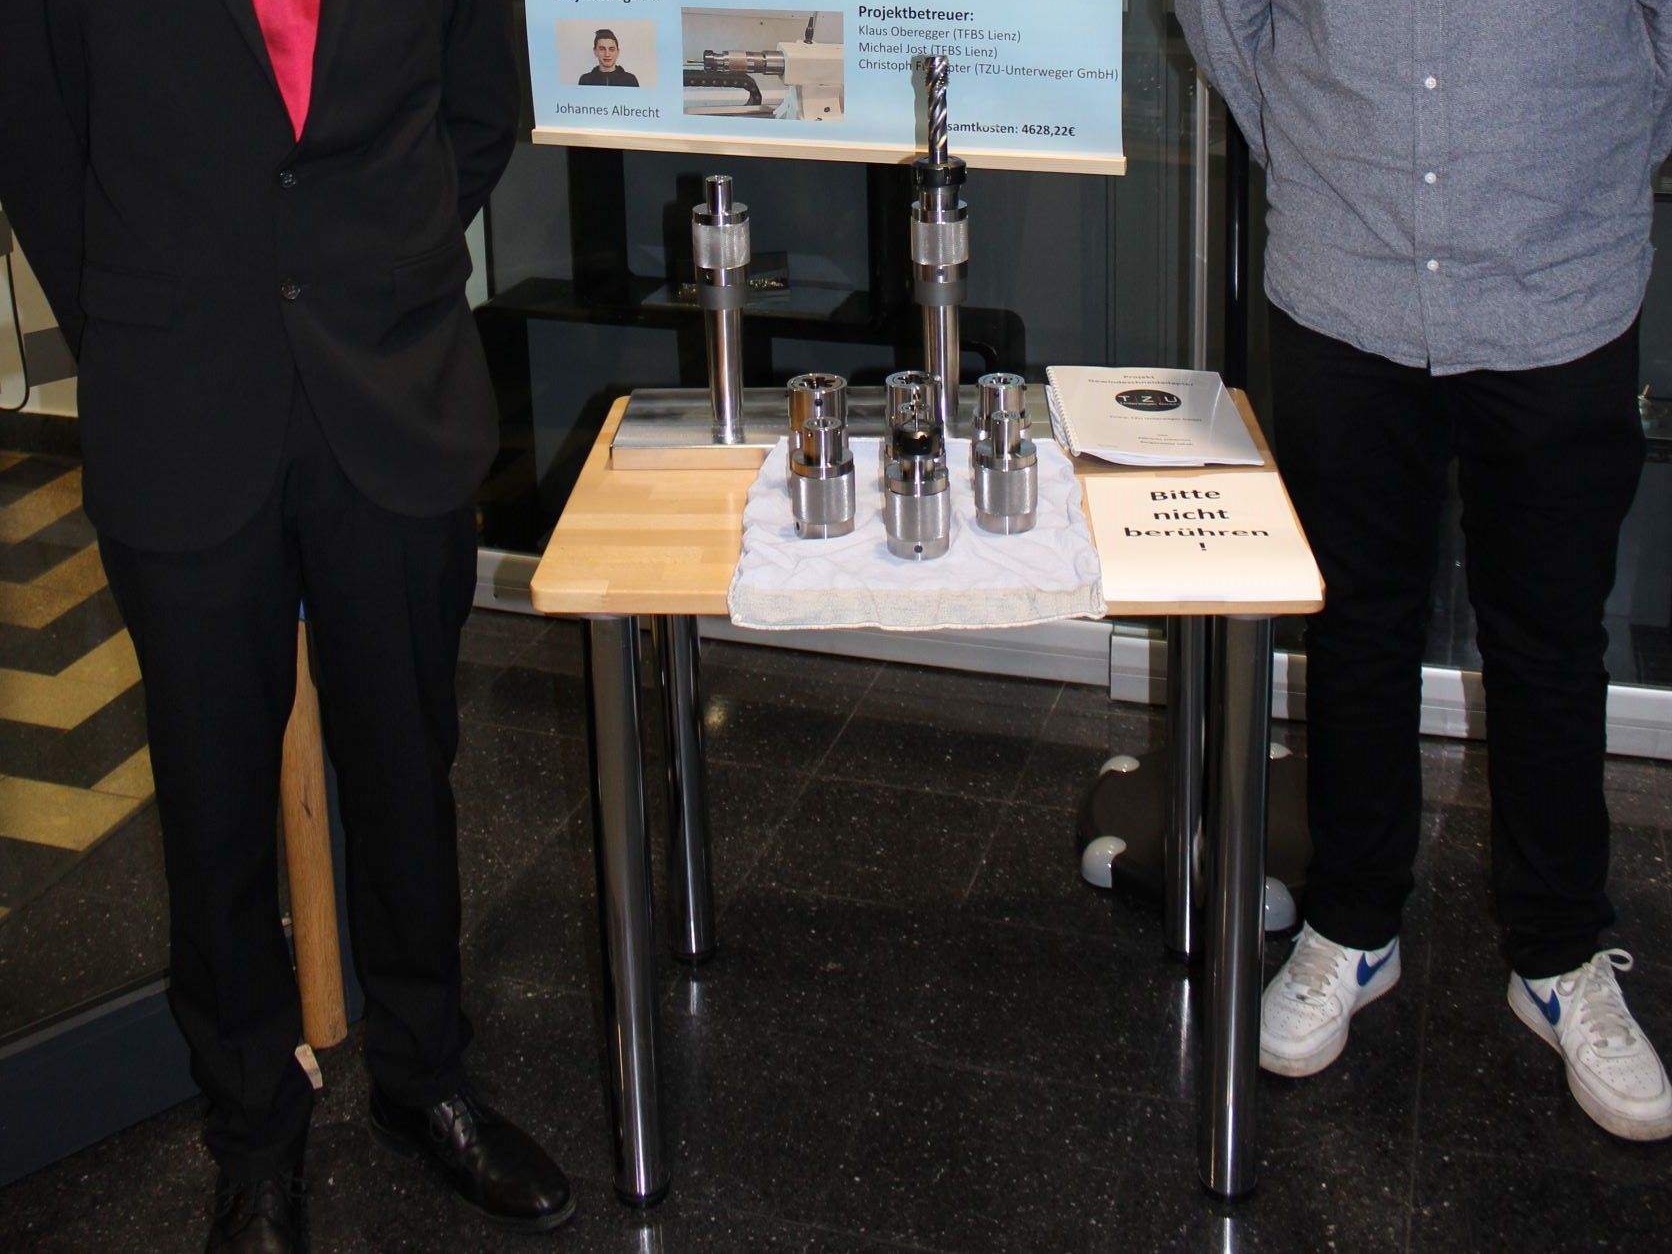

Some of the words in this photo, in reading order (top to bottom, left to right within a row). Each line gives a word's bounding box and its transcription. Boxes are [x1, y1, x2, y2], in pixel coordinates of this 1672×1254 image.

[858, 5, 974, 22] Projektbetreuer:
[858, 25, 888, 37] Klaus
[890, 26, 950, 40] Oberegger
[953, 28, 985, 41] (TFBS
[988, 29, 1021, 43] Lienz)
[858, 42, 903, 54] Michael
[905, 44, 927, 55] Jost
[930, 44, 962, 56] (TFBS
[965, 46, 998, 59] Lienz)
[858, 59, 912, 72] Christoph
[974, 62, 1073, 80] (TZU-Unterweger
[1077, 67, 1119, 81] GmbH)
[555, 102, 609, 116] Johannes
[612, 105, 661, 119] Albrecht
[947, 121, 1019, 135] samtkosten:
[1022, 123, 1077, 137] 4628,22€
[1150, 489, 1221, 501] Bitte
[1153, 508, 1230, 520] nicht
[1124, 527, 1270, 537] berühren
